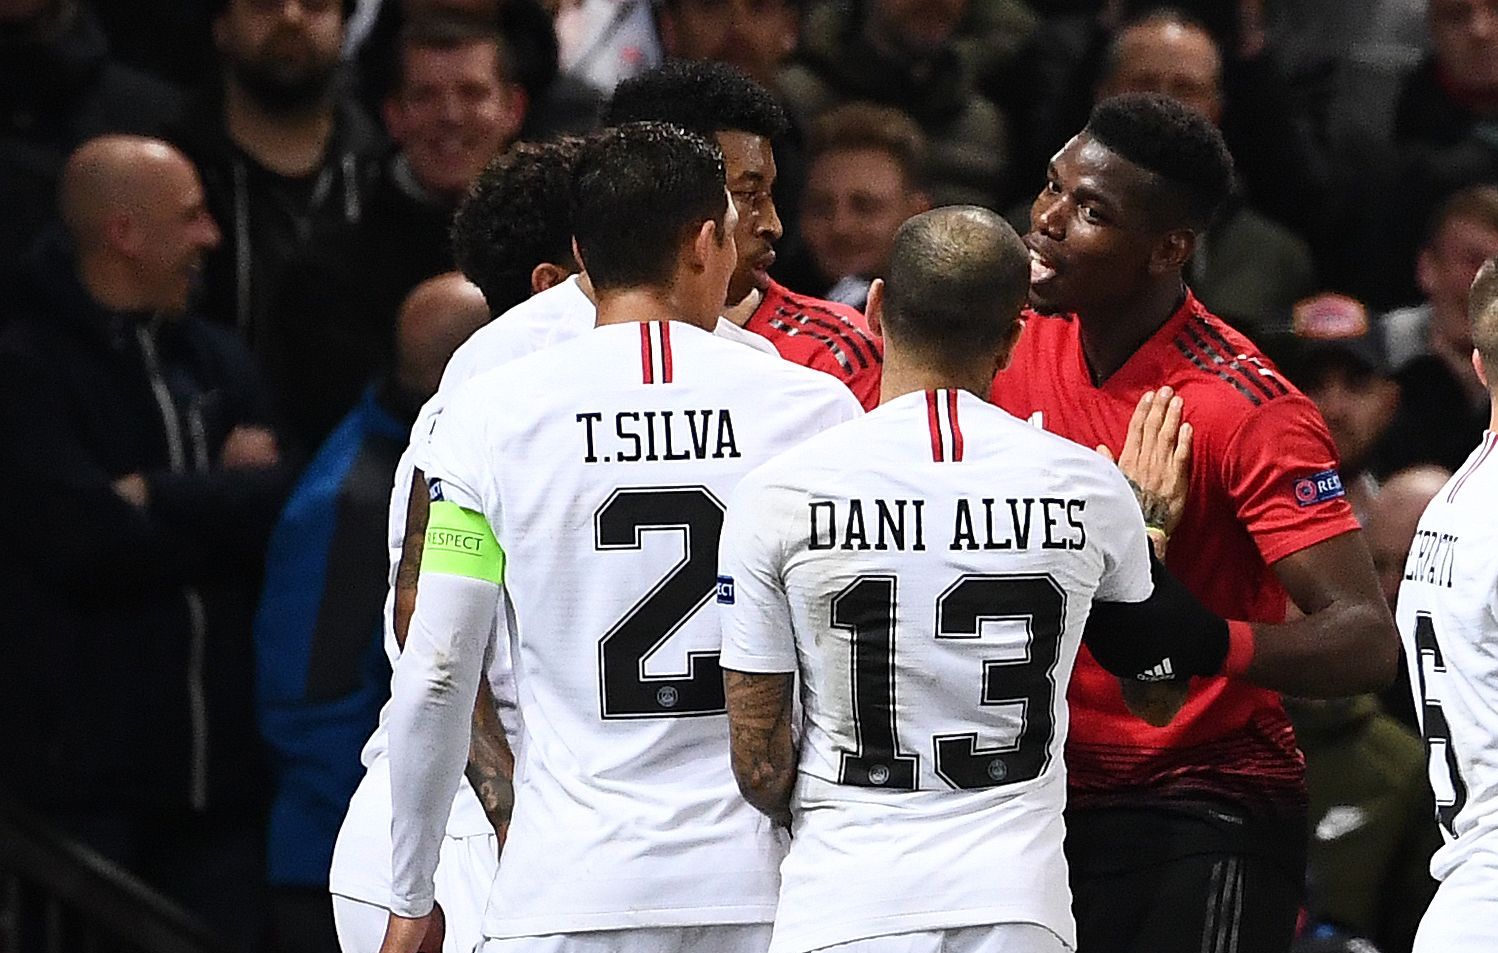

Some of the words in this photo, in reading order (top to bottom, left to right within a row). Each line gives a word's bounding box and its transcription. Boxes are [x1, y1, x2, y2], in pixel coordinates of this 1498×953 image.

[576, 409, 742, 463] T.SILVA
[808, 499, 926, 550] DANI
[949, 498, 1087, 550] ALVES
[594, 484, 728, 720] 2
[830, 572, 1068, 791] 13
